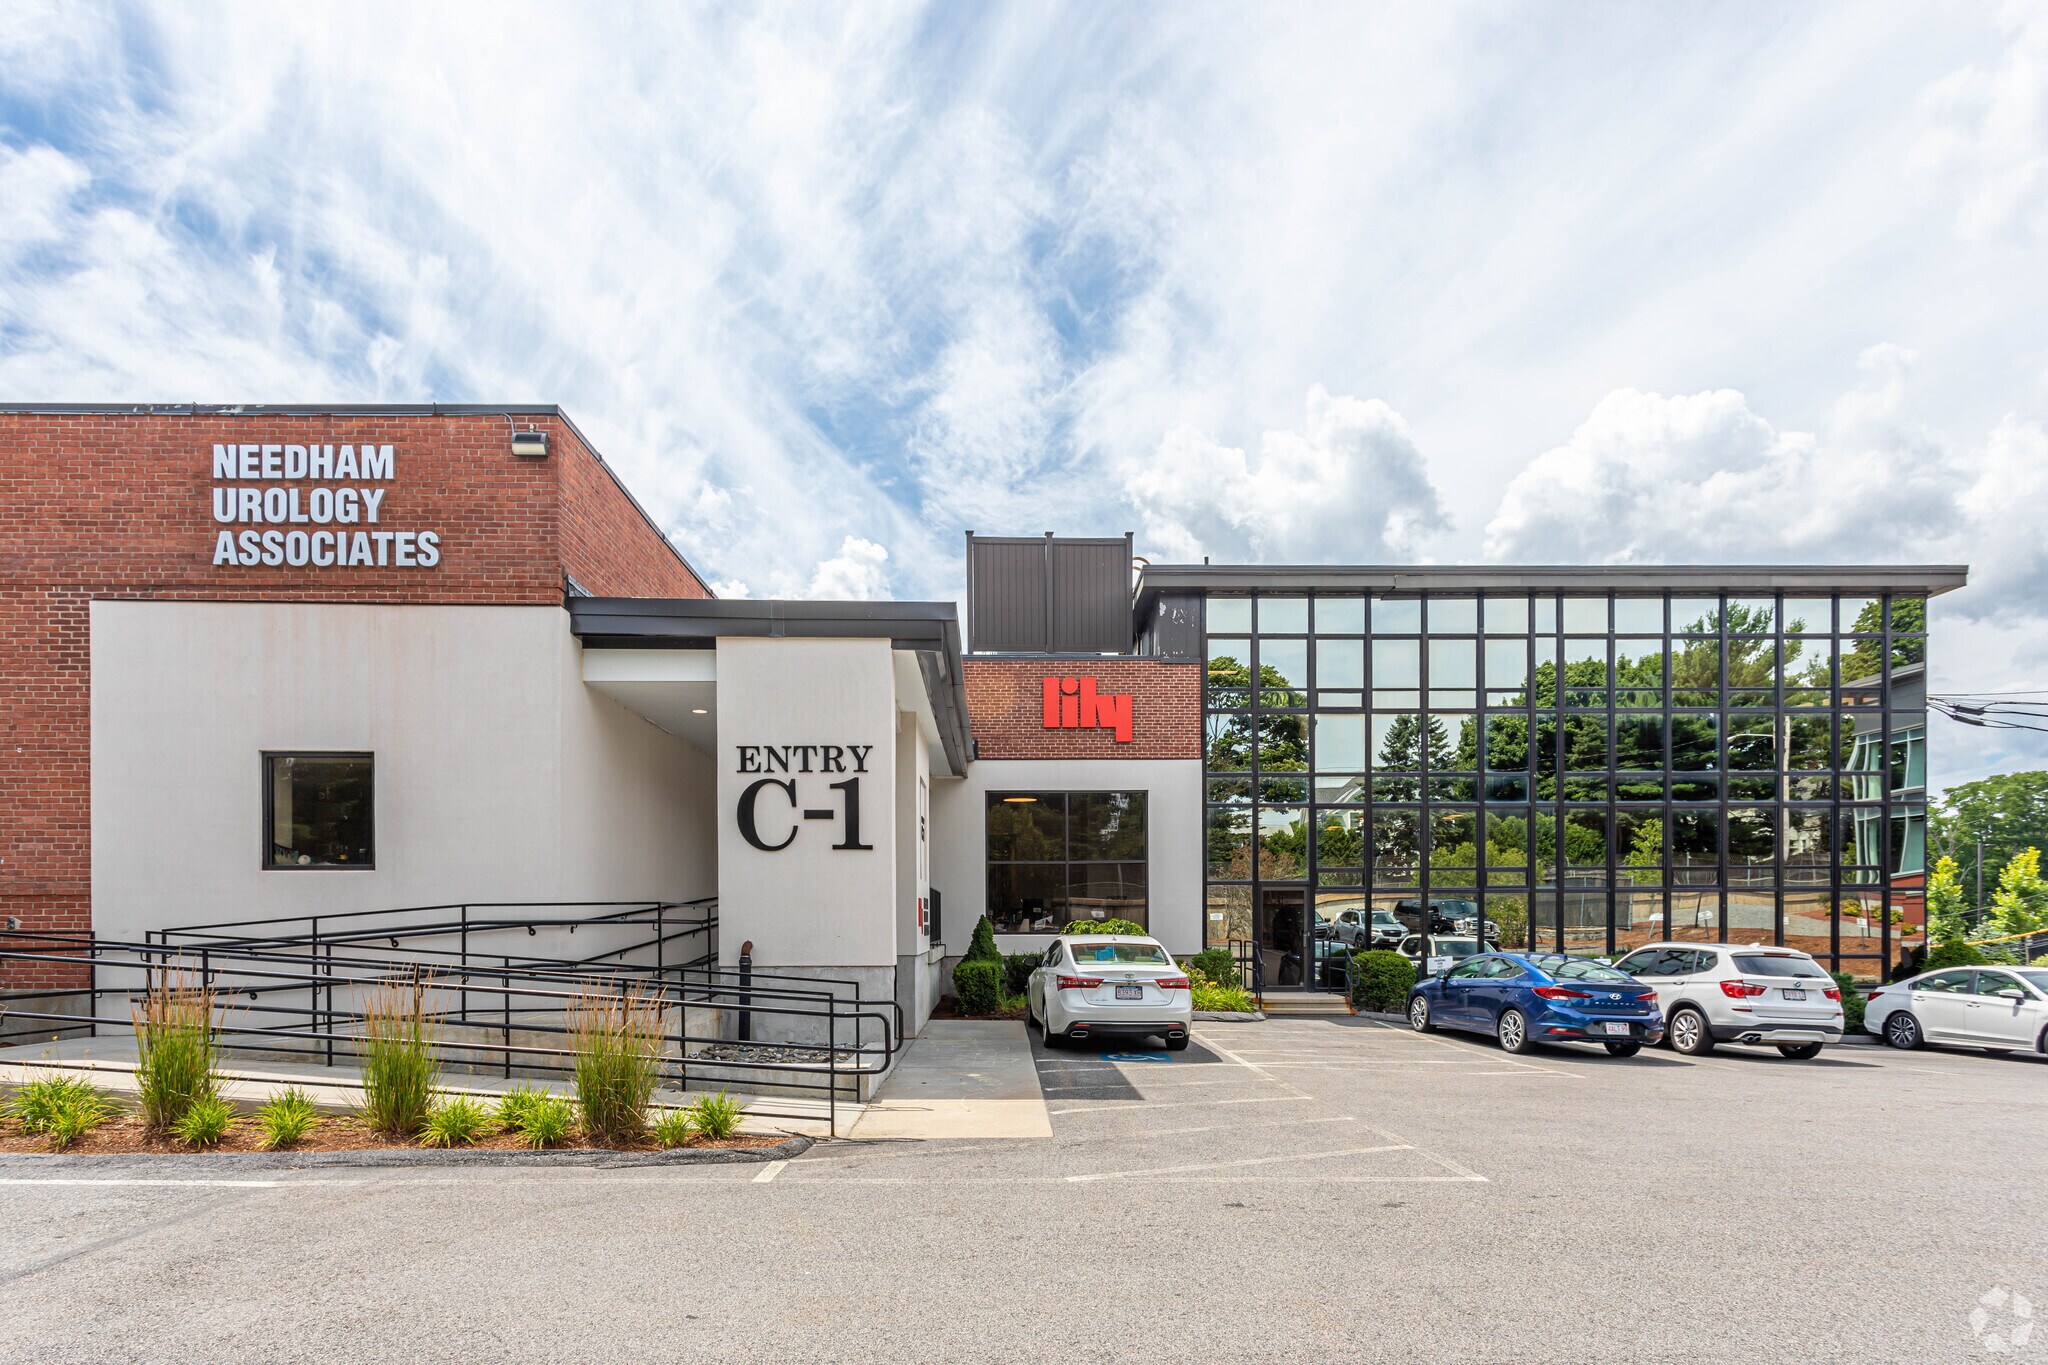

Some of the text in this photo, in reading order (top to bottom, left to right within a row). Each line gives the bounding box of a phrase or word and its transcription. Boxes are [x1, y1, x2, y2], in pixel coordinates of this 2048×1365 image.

[212, 444, 395, 480] NEEDHAM
[212, 487, 386, 524] UROLOGY
[212, 530, 441, 567] ASSOCIATES
[1043, 676, 1133, 742] lily
[736, 745, 873, 773] ENTRY
[736, 777, 874, 851] C-1
